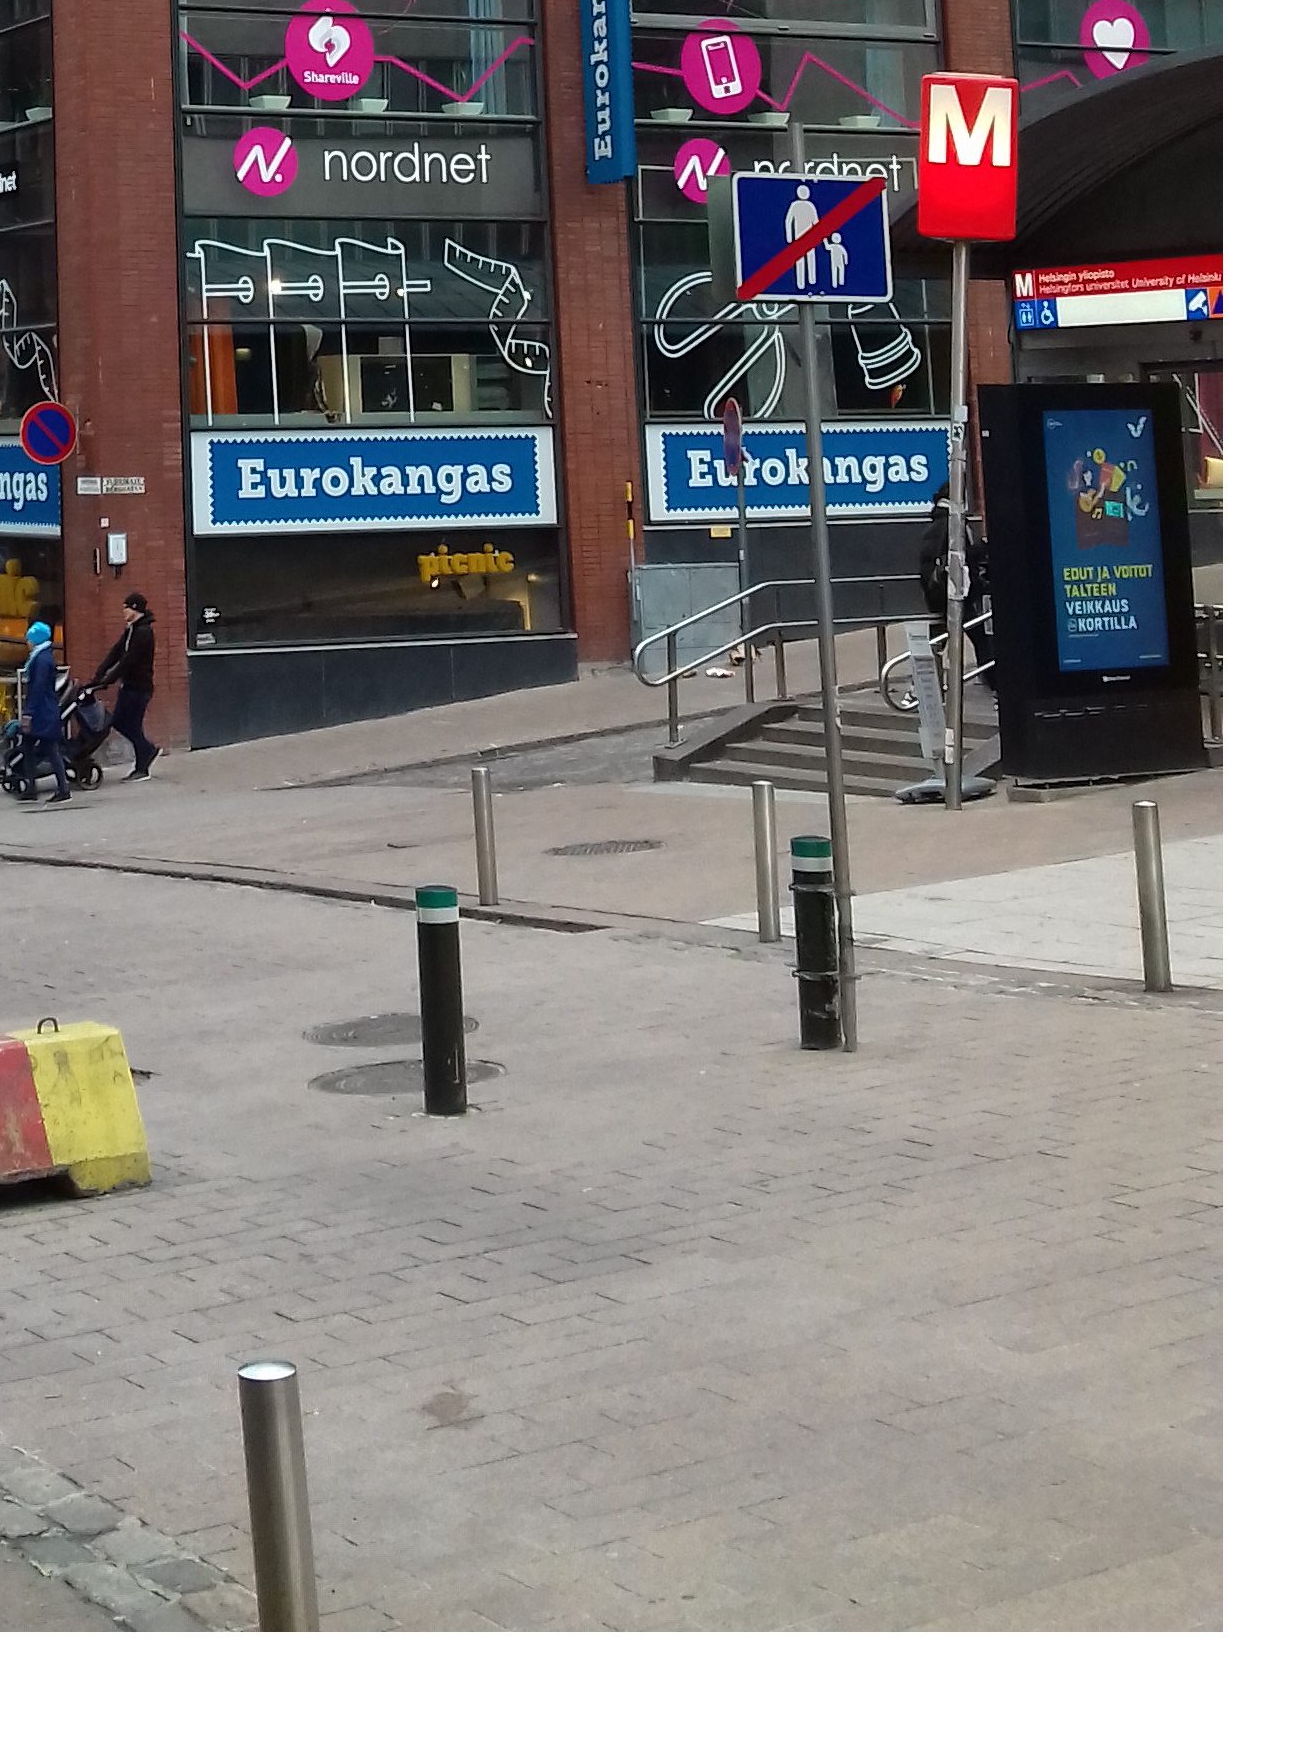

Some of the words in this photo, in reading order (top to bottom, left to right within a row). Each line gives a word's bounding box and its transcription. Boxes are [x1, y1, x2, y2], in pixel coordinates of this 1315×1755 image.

[303, 70, 360, 85] Shareville
[927, 83, 1013, 167] M
[323, 141, 492, 184] nordnet
[1015, 273, 1034, 297] M
[1038, 273, 1077, 284] Helsingin
[1078, 269, 1115, 282] yliopisto
[1039, 282, 1084, 295] Helsingfors
[1131, 274, 1174, 289] University
[1175, 273, 1186, 284] of
[236, 456, 514, 504] Eurokangas
[417, 543, 515, 582] picnic
[1063, 566, 1094, 581] EDUT
[1097, 566, 1111, 582] JA
[1113, 563, 1153, 579] VOITOT
[1064, 583, 1117, 598] TALTEEN
[1066, 598, 1130, 615] VEIKKAUS
[1078, 615, 1139, 632] KORTILLA
